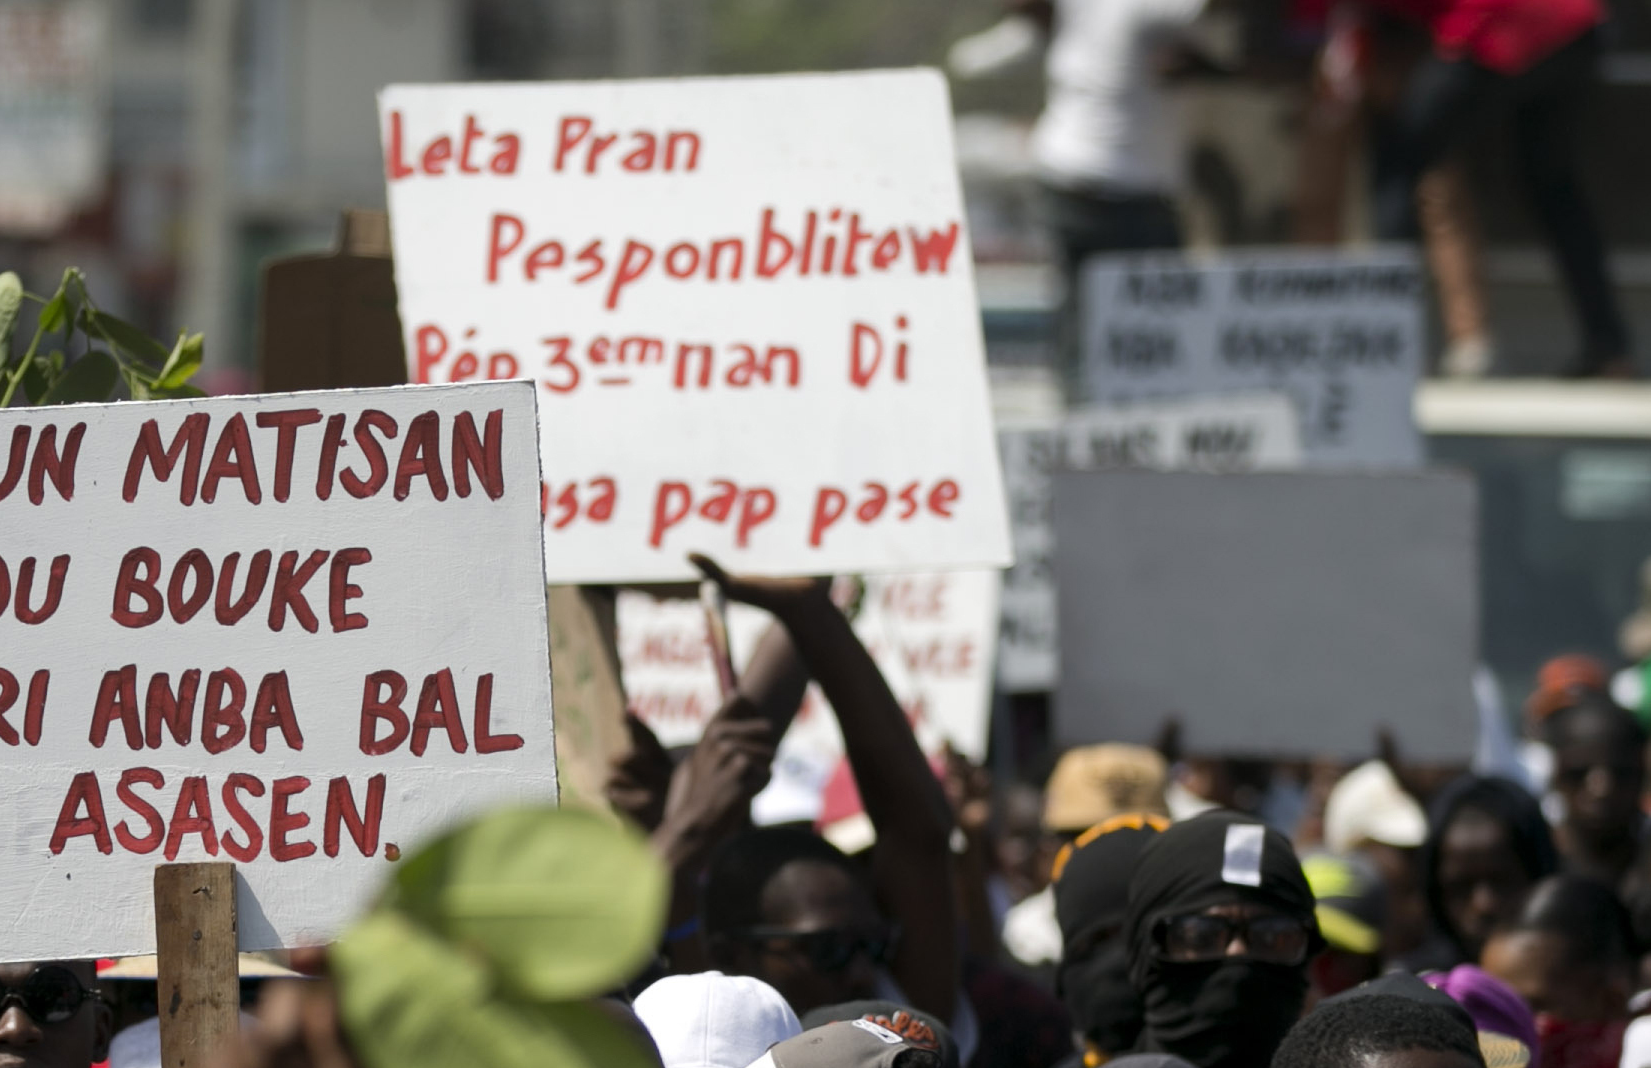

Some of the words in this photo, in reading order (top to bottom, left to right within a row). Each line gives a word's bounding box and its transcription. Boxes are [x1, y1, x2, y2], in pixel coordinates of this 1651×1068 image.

[387, 111, 521, 180] Leta
[552, 115, 702, 174] Pran
[848, 316, 911, 388] Di
[122, 408, 505, 506] MATISAN
[649, 478, 777, 549] pap
[808, 476, 960, 549] pase
[111, 546, 372, 633] BOUKE
[88, 664, 303, 754] ANBA
[359, 668, 524, 757] BAL
[49, 767, 401, 863] ASASEN.
